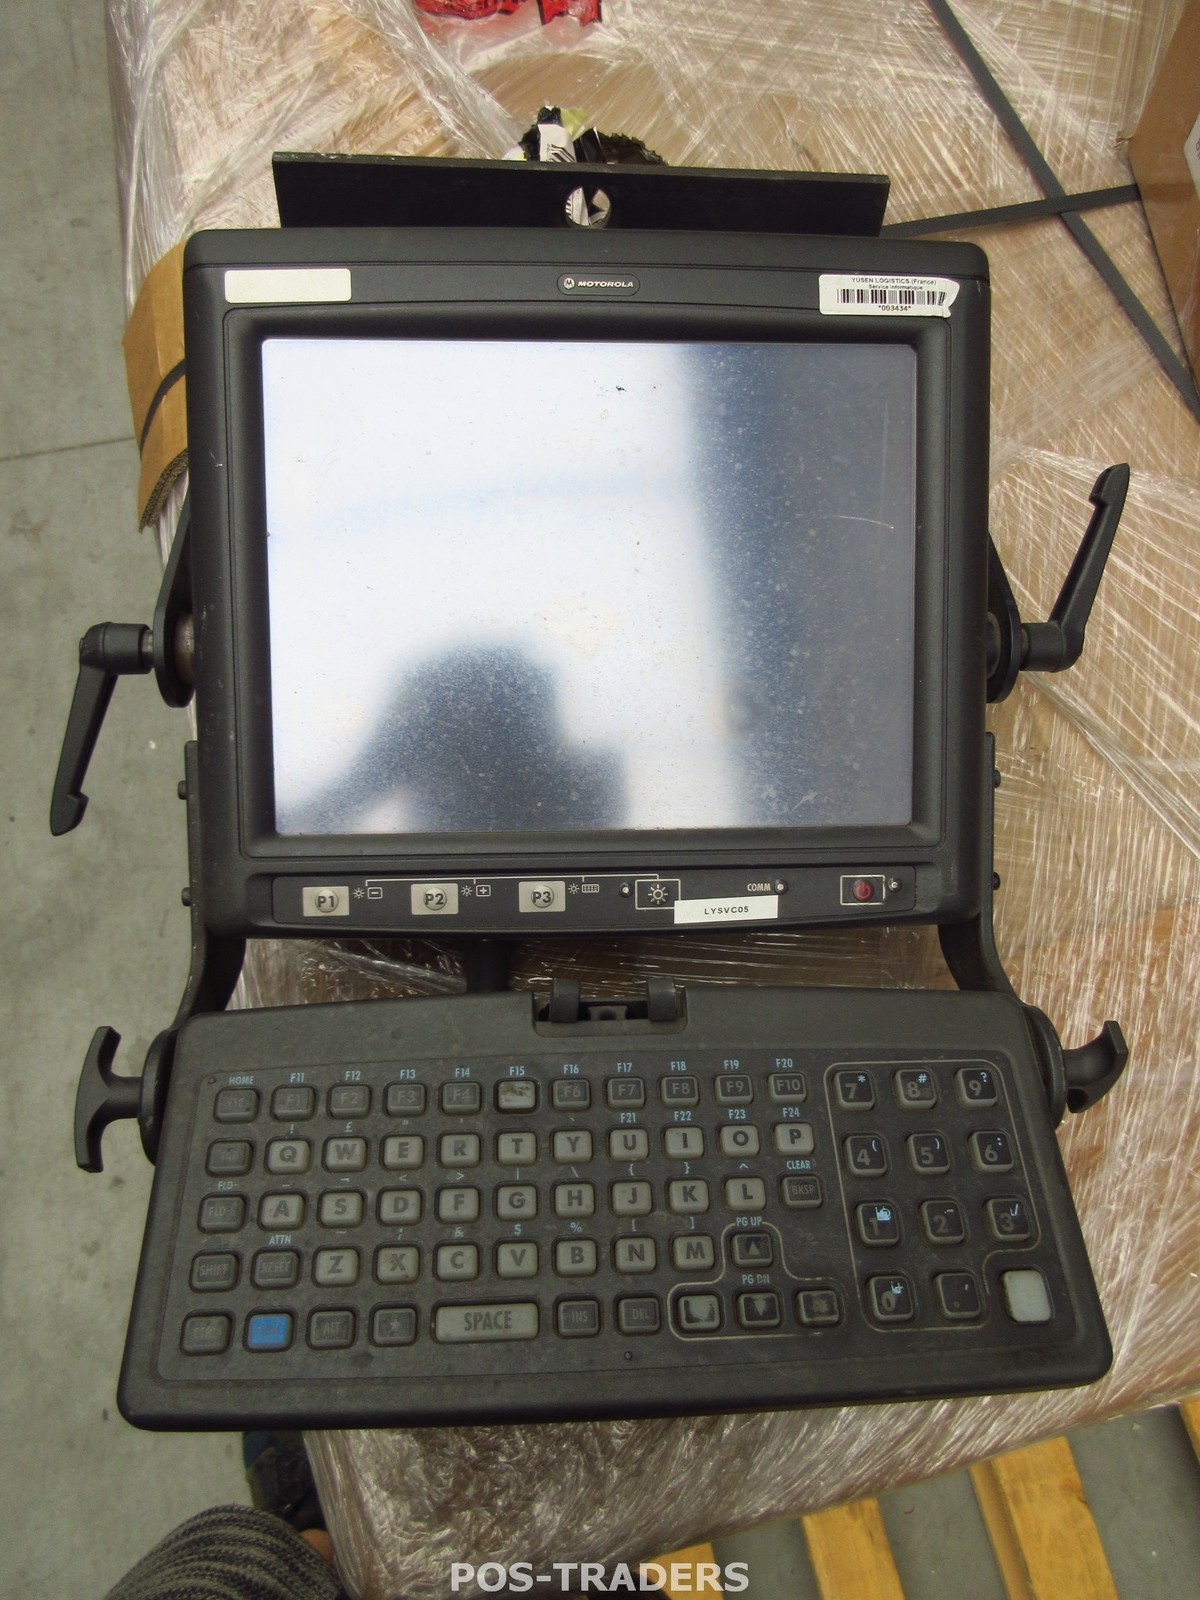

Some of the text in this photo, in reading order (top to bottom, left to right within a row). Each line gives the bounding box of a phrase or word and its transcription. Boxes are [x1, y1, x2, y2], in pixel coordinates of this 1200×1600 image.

[747, 883, 771, 892] COMM
[317, 895, 335, 908] P1
[424, 892, 444, 906] P2
[532, 890, 552, 904] P3
[704, 905, 749, 915] LYSVC05
[509, 1066, 526, 1076] F15
[563, 1064, 580, 1074] F16
[617, 1062, 633, 1073] F17
[670, 1061, 687, 1071] F18
[723, 1060, 740, 1070] F19
[775, 1058, 793, 1068] F20
[228, 1075, 255, 1086] HOME
[290, 1072, 305, 1083] F11
[345, 1070, 362, 1081] F12
[400, 1069, 416, 1080] F13
[454, 1067, 471, 1078] F14
[564, 1087, 581, 1098] F6
[618, 1084, 636, 1096] F7
[672, 1082, 690, 1094] F8
[725, 1080, 744, 1093] F9
[776, 1078, 801, 1091] F10
[844, 1082, 857, 1100] 7
[907, 1081, 919, 1098] 8
[968, 1079, 981, 1096] 9
[339, 1092, 359, 1104] F2
[398, 1090, 416, 1103] F3
[453, 1089, 471, 1101] F4
[620, 1112, 636, 1123] F21
[673, 1110, 692, 1121] F22
[728, 1109, 746, 1119] F23
[782, 1107, 800, 1117] F24
[566, 1136, 580, 1153] Y
[622, 1134, 637, 1150] U
[682, 1132, 688, 1149] I
[732, 1130, 749, 1146] O
[789, 1128, 801, 1145] P
[280, 1145, 297, 1163] Q
[334, 1143, 357, 1161] W
[397, 1142, 409, 1158] E
[453, 1140, 467, 1156] R
[511, 1138, 523, 1154] T
[984, 1144, 998, 1162] 6
[856, 1148, 871, 1166] 4
[920, 1146, 934, 1164] 5
[786, 1160, 812, 1170] CLEAR
[508, 1191, 526, 1208] G
[567, 1189, 583, 1207] H
[627, 1186, 638, 1205] J
[682, 1185, 699, 1203] K
[741, 1183, 753, 1200] L
[273, 1200, 290, 1217] A
[334, 1198, 347, 1215] S
[393, 1196, 409, 1213] D
[453, 1193, 465, 1211] F
[736, 1216, 763, 1227] PG UP
[869, 1217, 880, 1235] 1
[933, 1214, 948, 1233] 2
[1001, 1212, 1015, 1232] 3
[268, 1235, 292, 1245] ATTN
[510, 1248, 527, 1267] V
[570, 1246, 585, 1264] B
[627, 1243, 645, 1261] N
[686, 1241, 706, 1260] M
[327, 1255, 344, 1275] Z
[389, 1253, 406, 1272] X
[450, 1251, 465, 1269] C
[742, 1273, 770, 1284] PG DN
[463, 1310, 512, 1331] SPACE
[571, 1310, 588, 1323] INS
